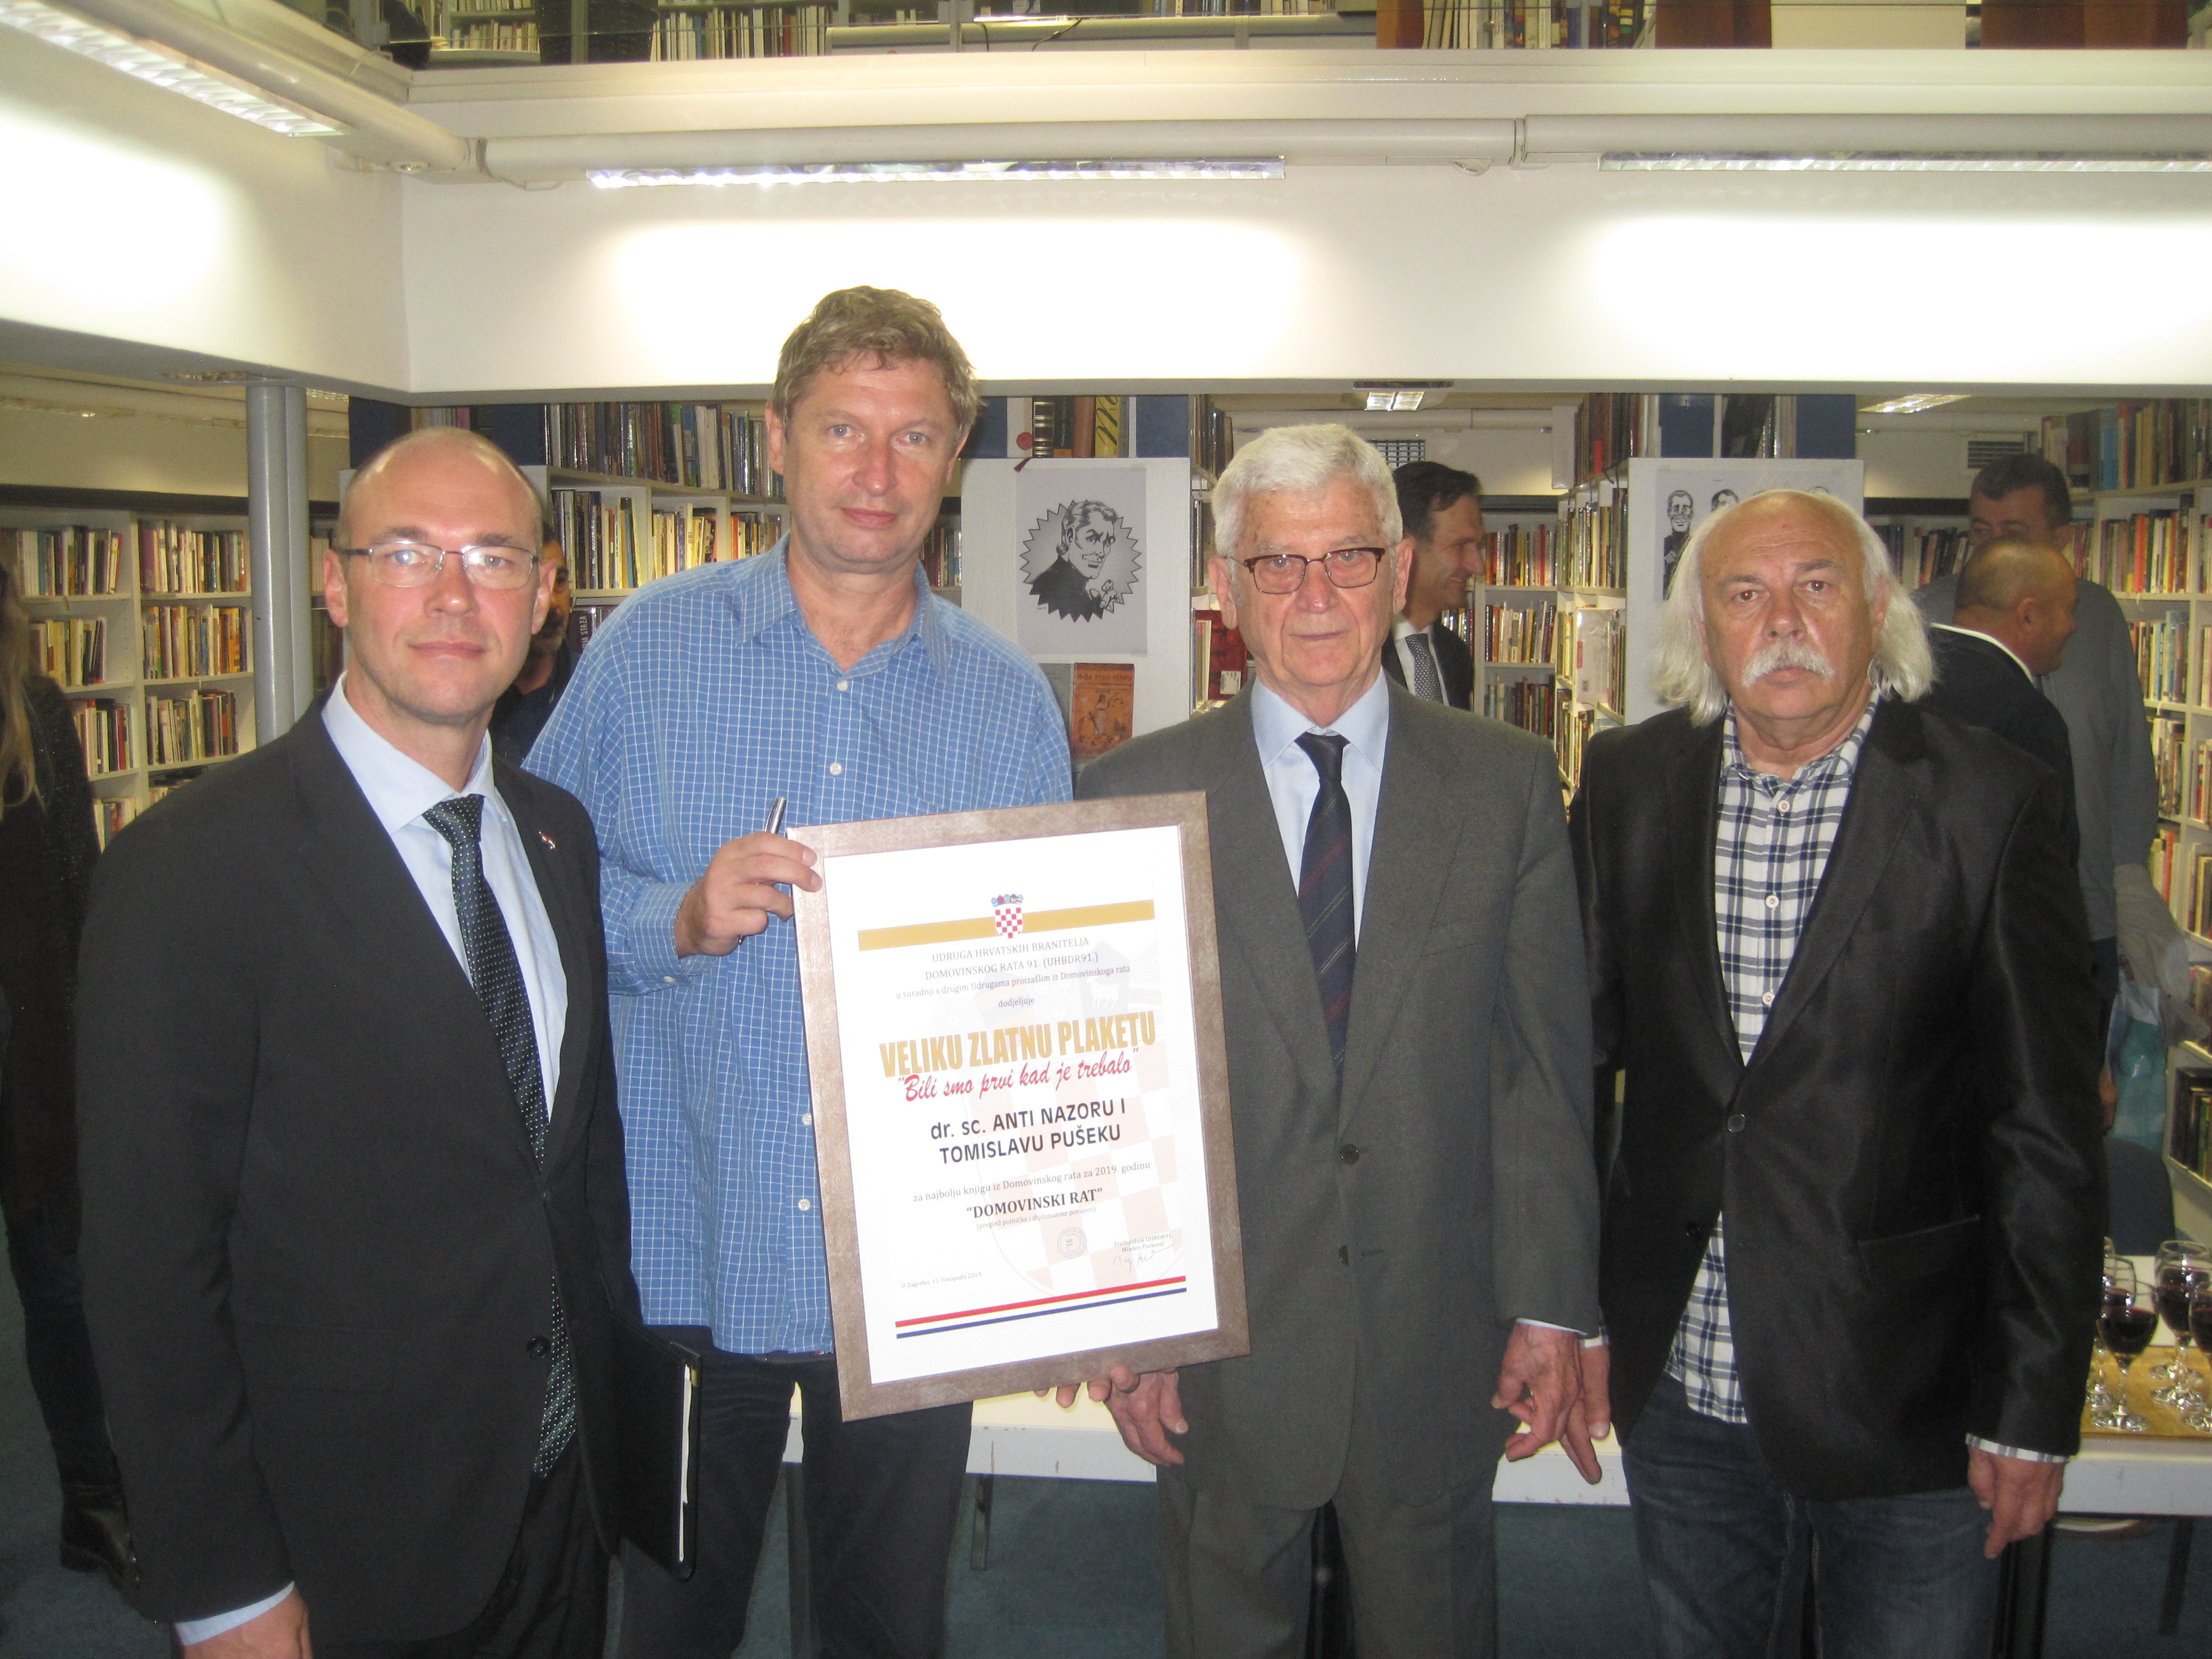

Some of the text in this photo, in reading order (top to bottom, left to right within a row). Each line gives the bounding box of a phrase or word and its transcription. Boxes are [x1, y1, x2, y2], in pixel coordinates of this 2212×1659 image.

[579, 615, 588, 635] STAZA
[925, 952, 1099, 980] DOMOVINSKOG RATA 91. (UHBDR91.)
[932, 937, 1089, 962] UDRUGA HRVATSKIH BRANITELJA
[902, 988, 934, 998] suradnji
[941, 985, 969, 994] drugim
[971, 980, 1010, 991] Udrugama
[1011, 974, 1051, 988] proizašlim
[1052, 973, 1059, 981] iz
[1060, 967, 1114, 980] Domovinskoga
[1116, 965, 1130, 974] rata
[998, 996, 1035, 1008] dodjeljuje
[879, 1011, 1156, 1078] VELIKU ZLATNU PLAKETU
[943, 1079, 974, 1097] smo
[979, 1069, 1014, 1100] prvi
[1019, 1061, 1051, 1087] kad
[1055, 1062, 1071, 1091] je
[931, 1122, 954, 1140] dr.
[961, 1119, 986, 1136] sc.
[993, 1110, 1034, 1131] ANTI
[1041, 1099, 1114, 1125] NAZORU
[939, 1124, 1121, 1164] TOMISLAVU PUŠEKU
[925, 1188, 961, 1201] najbolju
[964, 1185, 991, 1195] knjigu
[993, 1182, 1001, 1191] iz
[1002, 1175, 1062, 1190] Domovinskog
[1064, 1171, 1082, 1181] rata
[1094, 1165, 1119, 1176] 2019.
[1121, 1162, 1150, 1175] godinu
